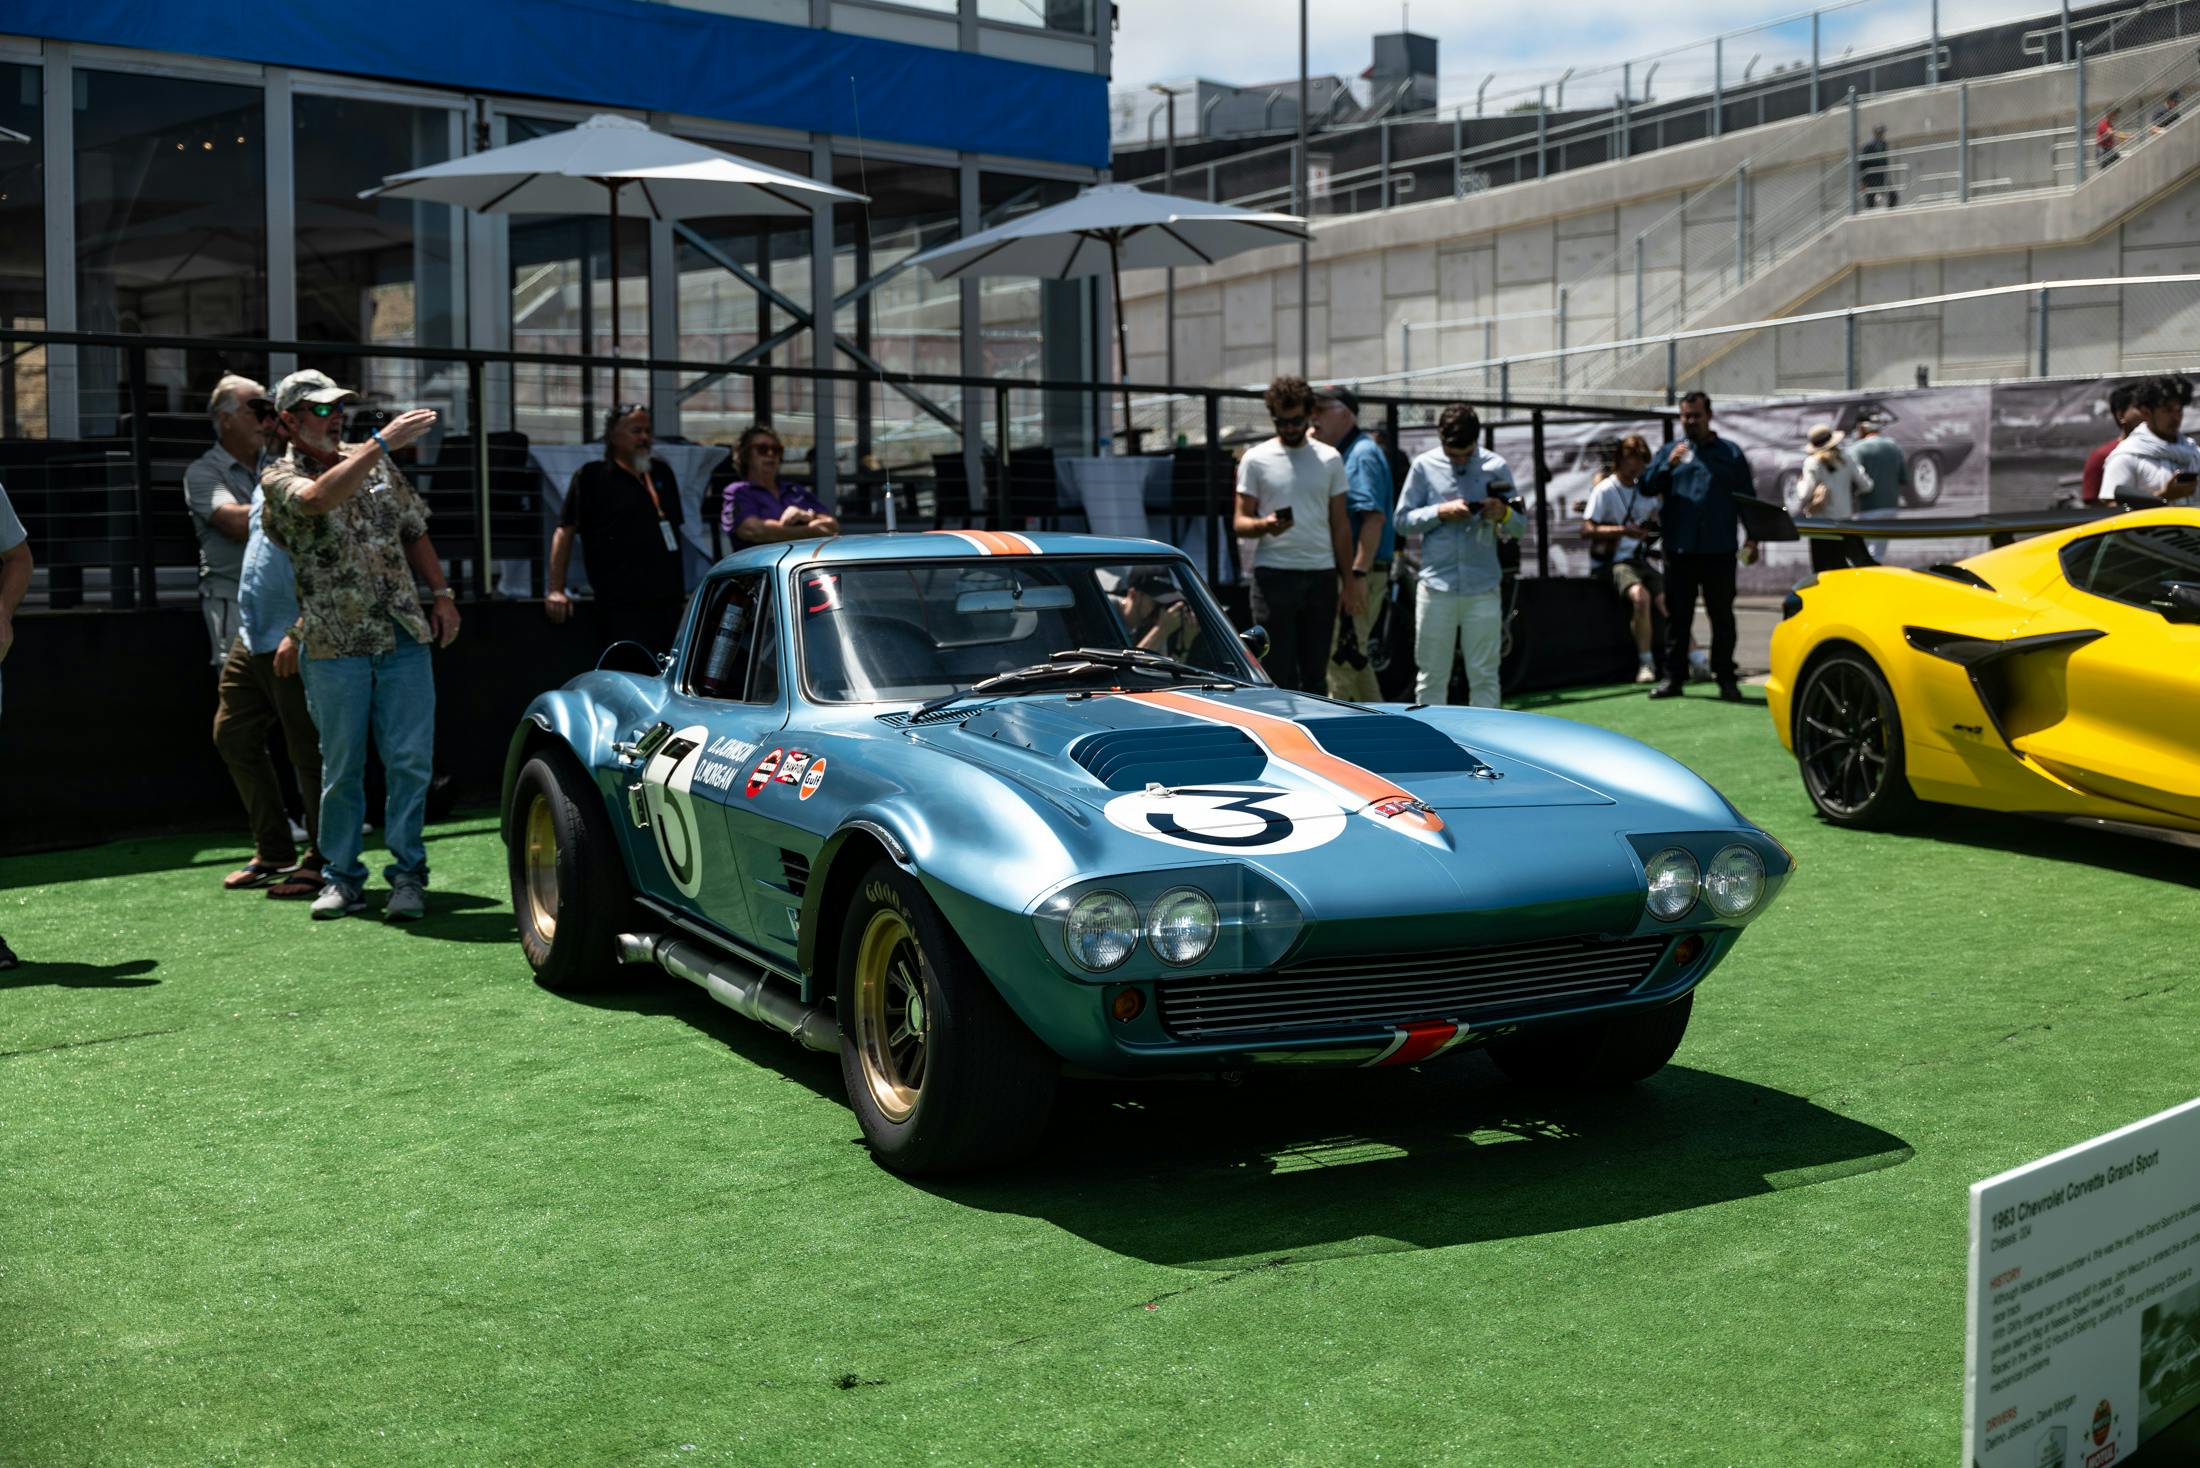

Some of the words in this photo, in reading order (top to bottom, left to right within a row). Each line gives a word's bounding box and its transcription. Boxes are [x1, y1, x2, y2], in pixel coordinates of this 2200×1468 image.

[694, 759, 739, 790] D.MORGAN
[804, 772, 822, 786] Gulf
[657, 737, 700, 885] 3
[1146, 789, 1294, 847] 3
[1992, 1206, 2016, 1232] 1963
[2018, 1187, 2065, 1222] Chevrolet
[2066, 1173, 2105, 1201] Corvette
[2107, 1158, 2134, 1185] Grand
[2136, 1149, 2159, 1175] Sport
